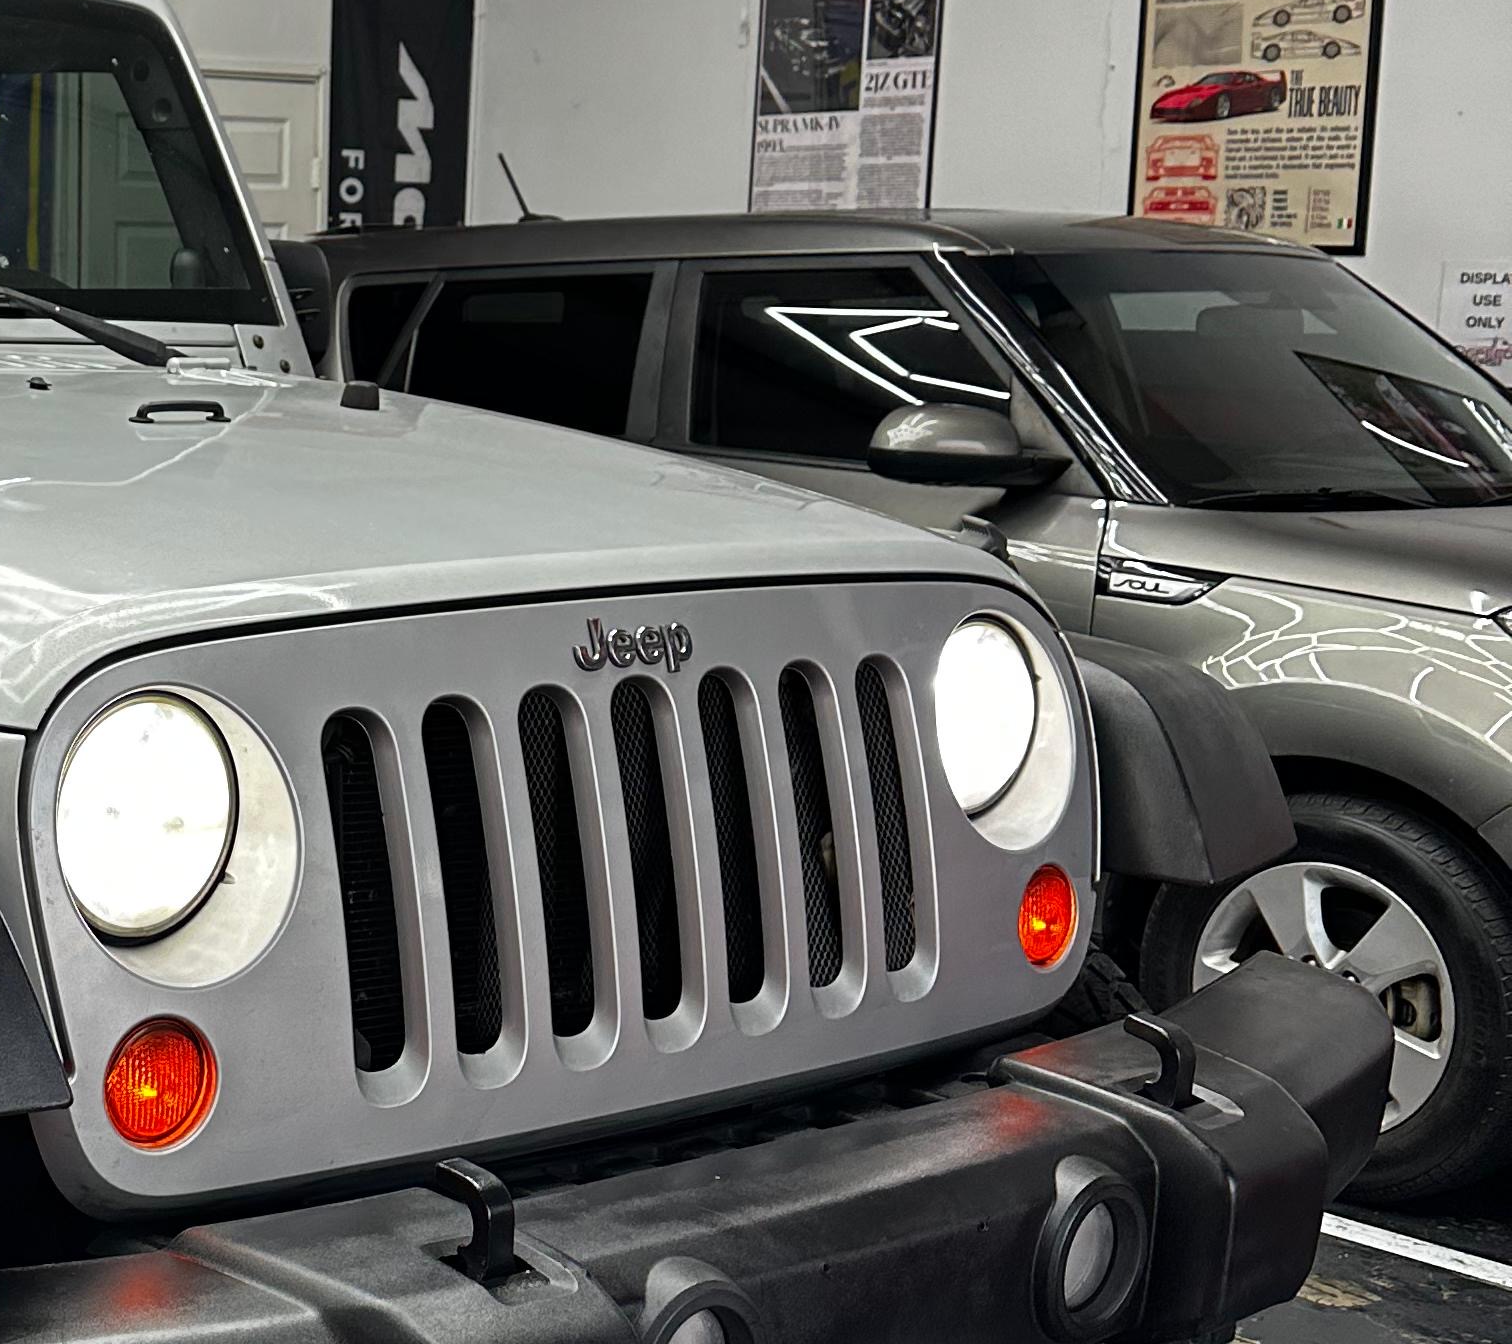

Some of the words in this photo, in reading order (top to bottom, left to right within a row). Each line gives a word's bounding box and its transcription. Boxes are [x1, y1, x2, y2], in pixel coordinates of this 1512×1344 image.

[1288, 86, 1316, 118] TRUE
[1318, 85, 1362, 118] BEAUTY
[1473, 294, 1502, 307] USE
[1465, 315, 1505, 329] ONLY
[572, 617, 693, 674] Jeep
